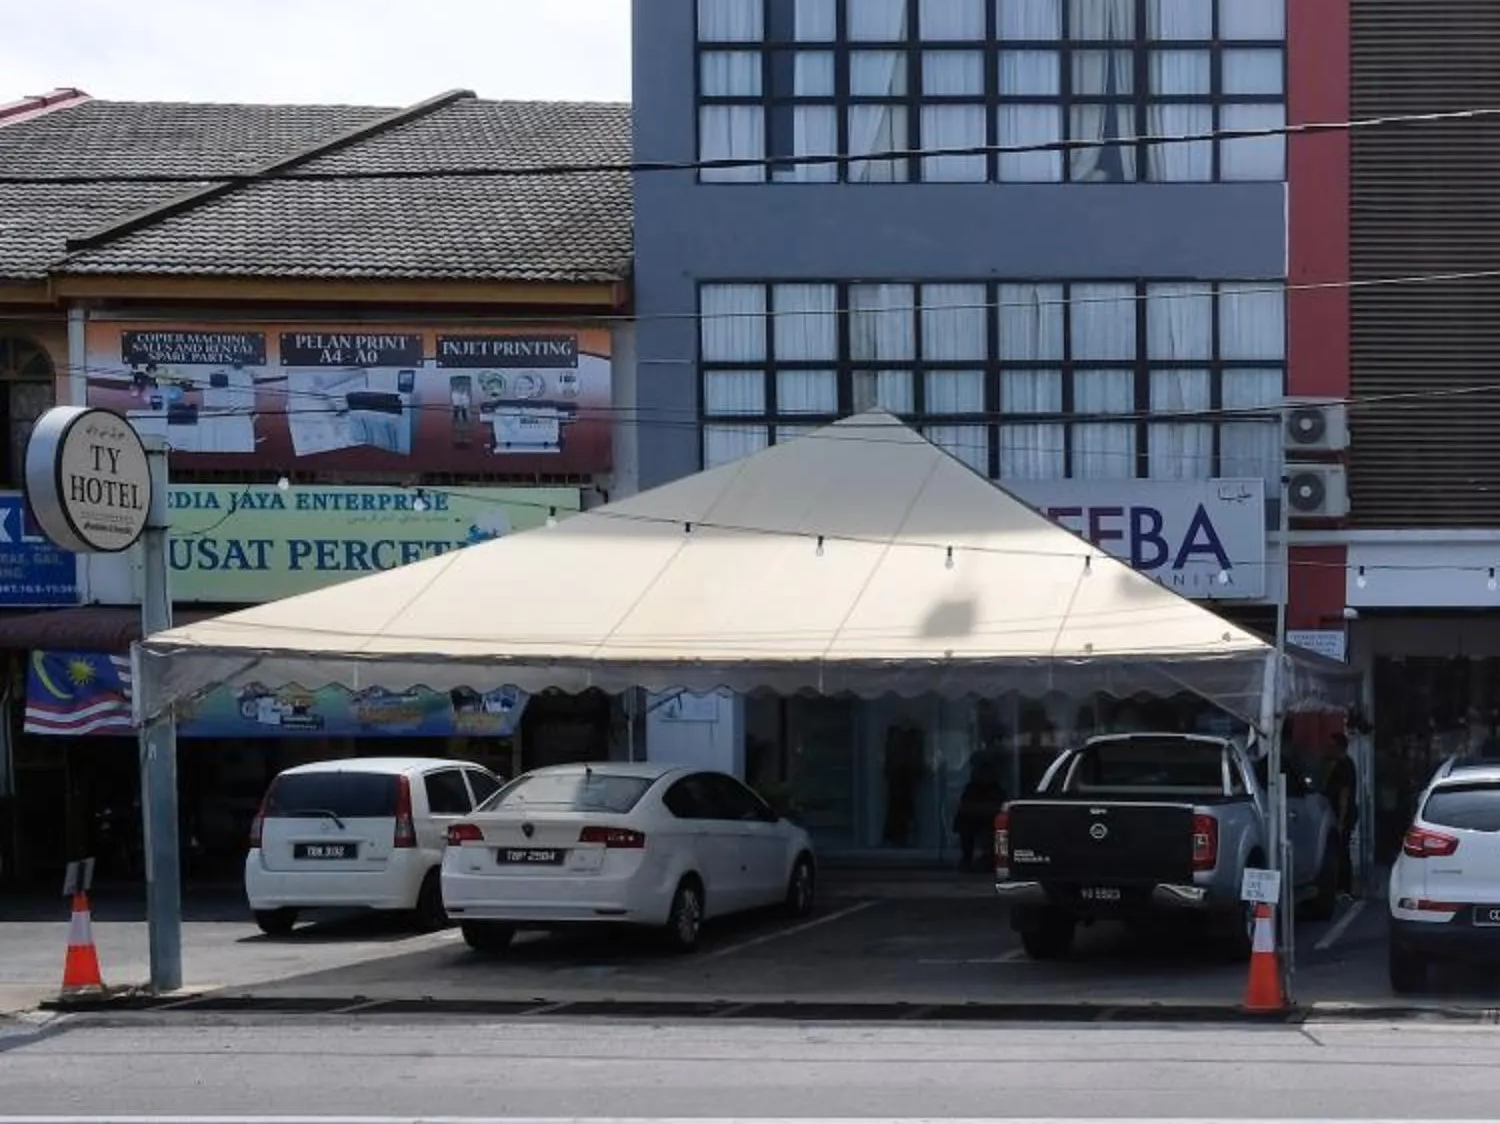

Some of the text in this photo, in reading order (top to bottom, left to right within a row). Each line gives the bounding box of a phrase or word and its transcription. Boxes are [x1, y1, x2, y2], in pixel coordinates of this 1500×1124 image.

[187, 334, 246, 344] MACHINE
[296, 335, 409, 350] PELAN PRINT
[174, 343, 203, 353] AND
[205, 343, 254, 353] RENTAL
[443, 341, 571, 356] INJET PRINTING
[148, 353, 187, 363] SPARE
[319, 351, 340, 364] A4
[90, 445, 121, 474] TY
[70, 474, 142, 511] HOTEL
[168, 491, 220, 509] DIA
[228, 491, 285, 515] JAYA
[169, 538, 469, 572] USAT PERCET
